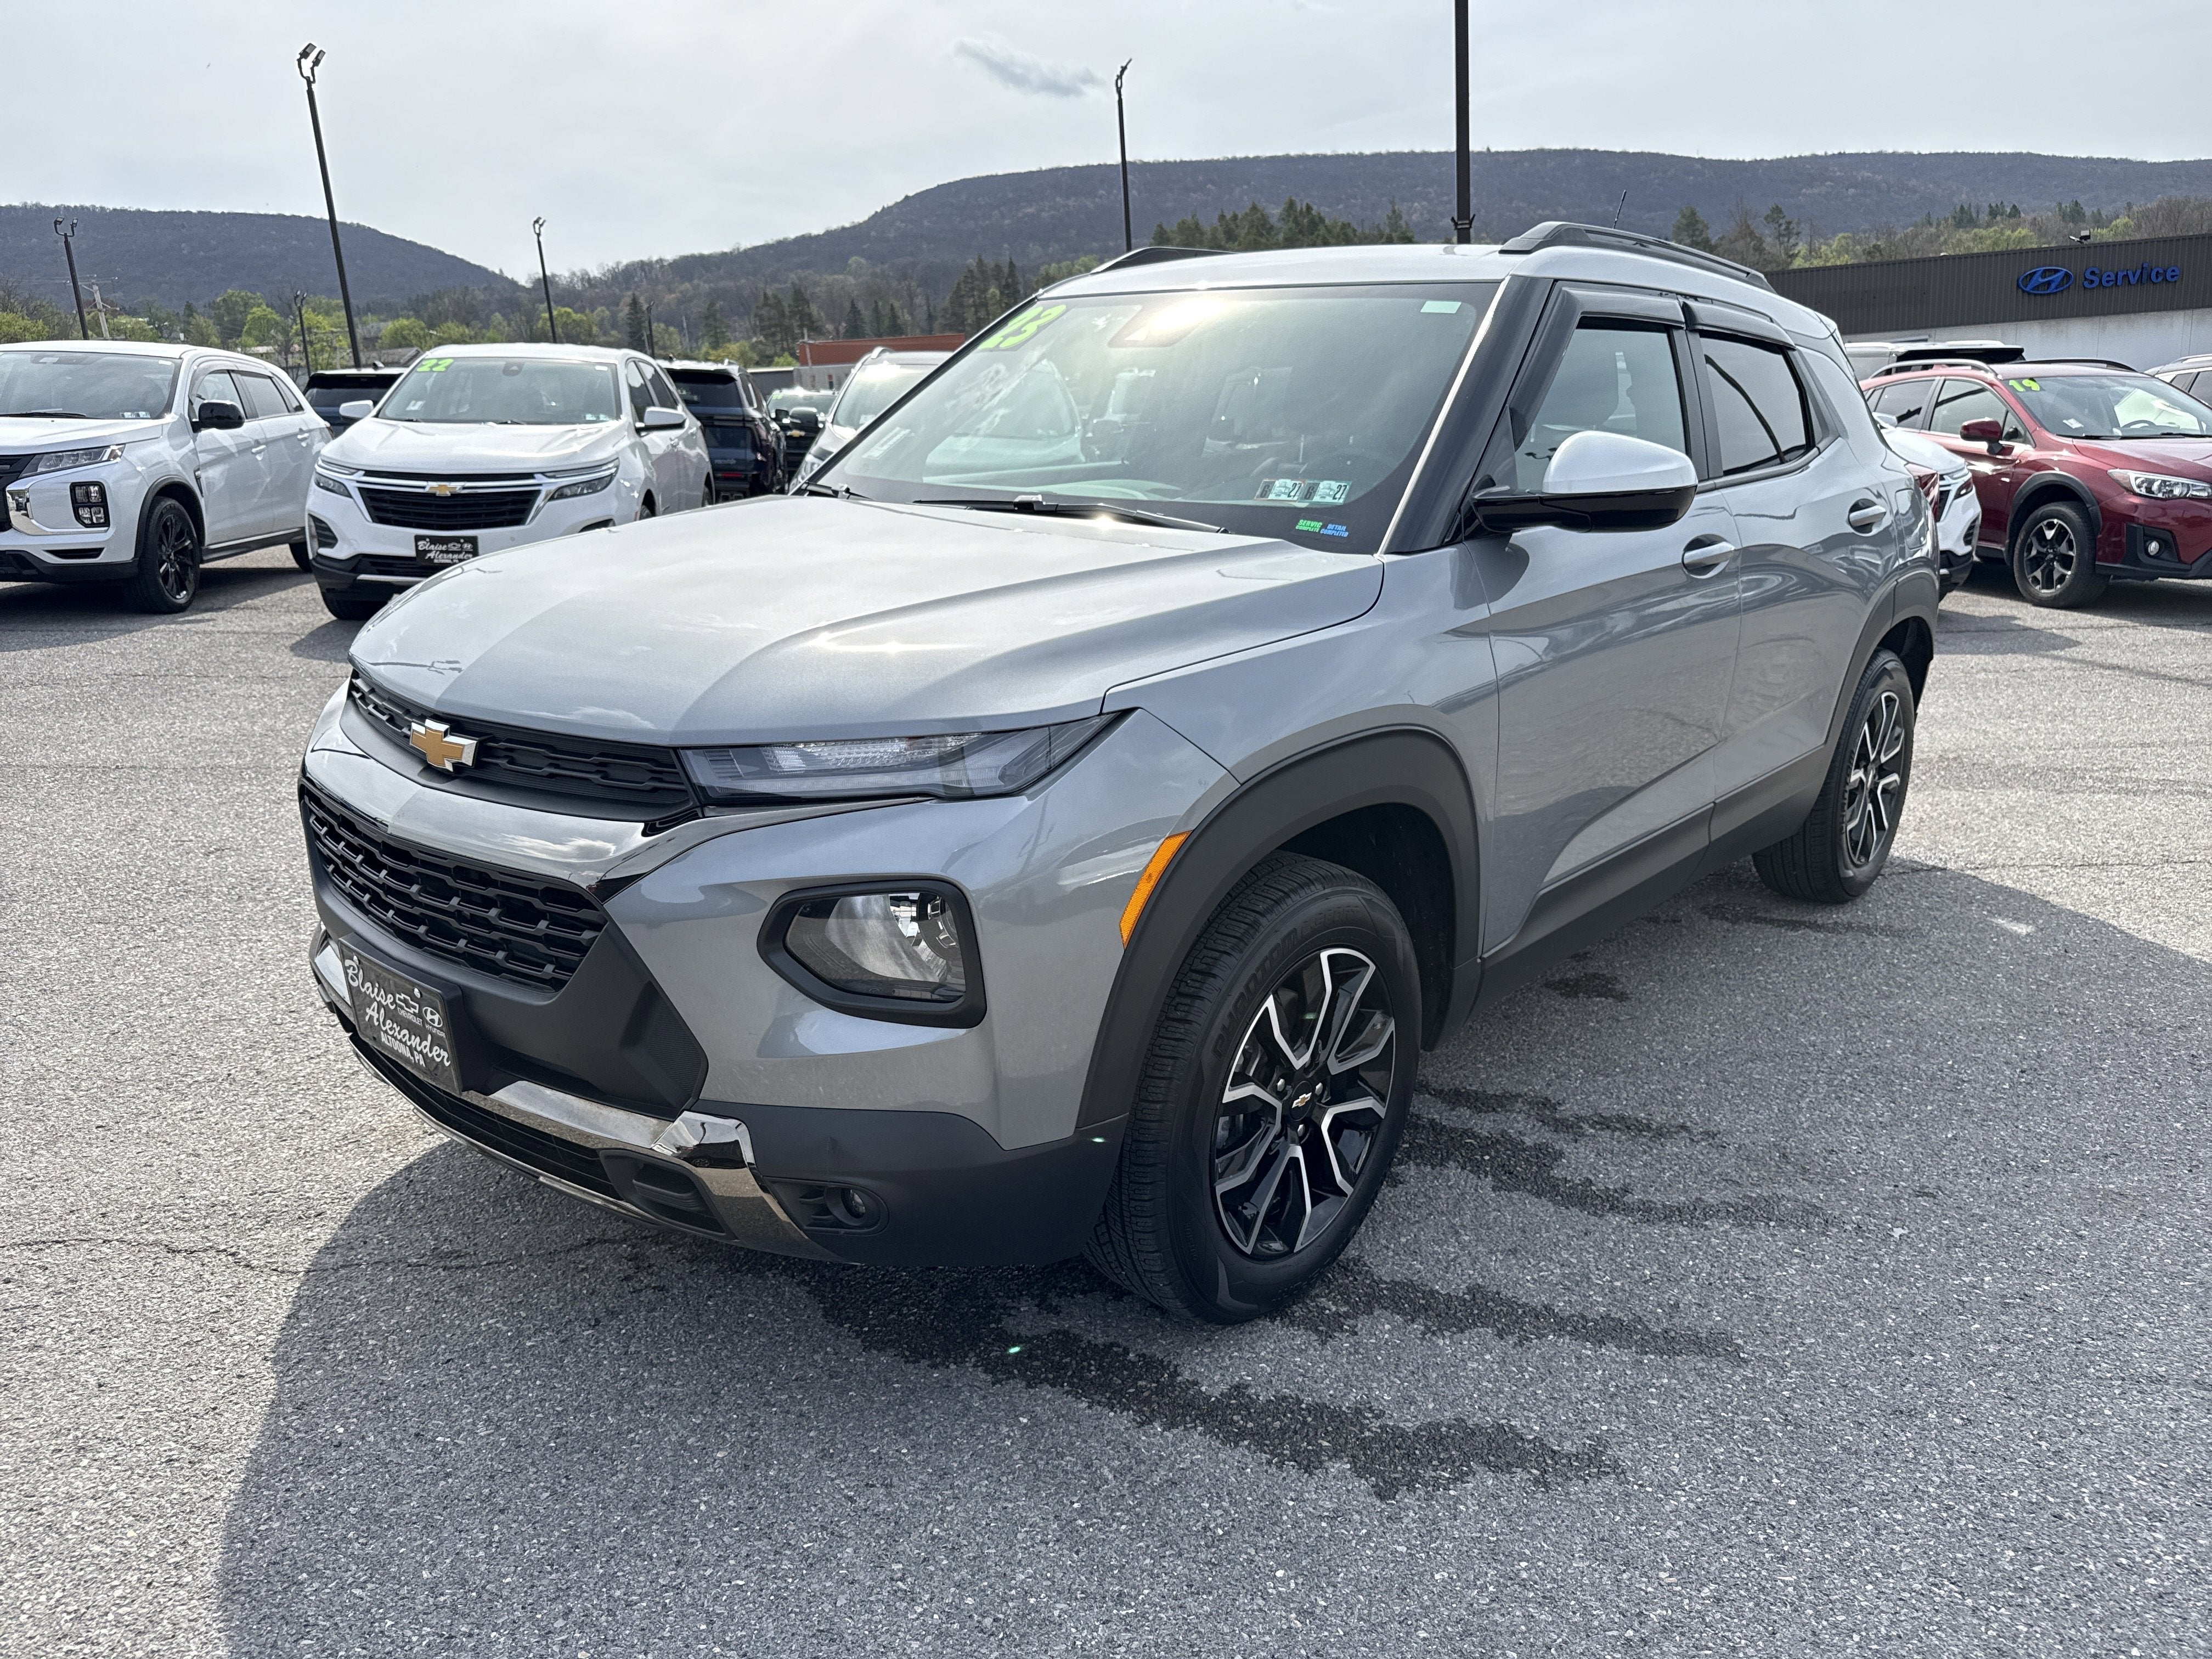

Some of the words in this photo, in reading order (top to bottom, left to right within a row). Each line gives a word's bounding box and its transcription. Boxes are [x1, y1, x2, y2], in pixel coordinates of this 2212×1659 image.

[2083, 263, 2180, 289] Service
[417, 358, 454, 372] 22
[2008, 379, 2040, 392] 19
[1286, 482, 1302, 500] 27
[1304, 486, 1315, 501] 6
[1332, 484, 1348, 501] 27
[1297, 520, 1322, 528] SERVIC
[1320, 528, 1348, 537] COMPLETED
[1327, 523, 1347, 532] DETAIL
[345, 959, 396, 1009] Blaise
[1212, 928, 1297, 1060] PHANTOM
[397, 1007, 423, 1026] CHEVROLET
[366, 1001, 451, 1066] Alexander
[414, 1053, 426, 1068] PA
